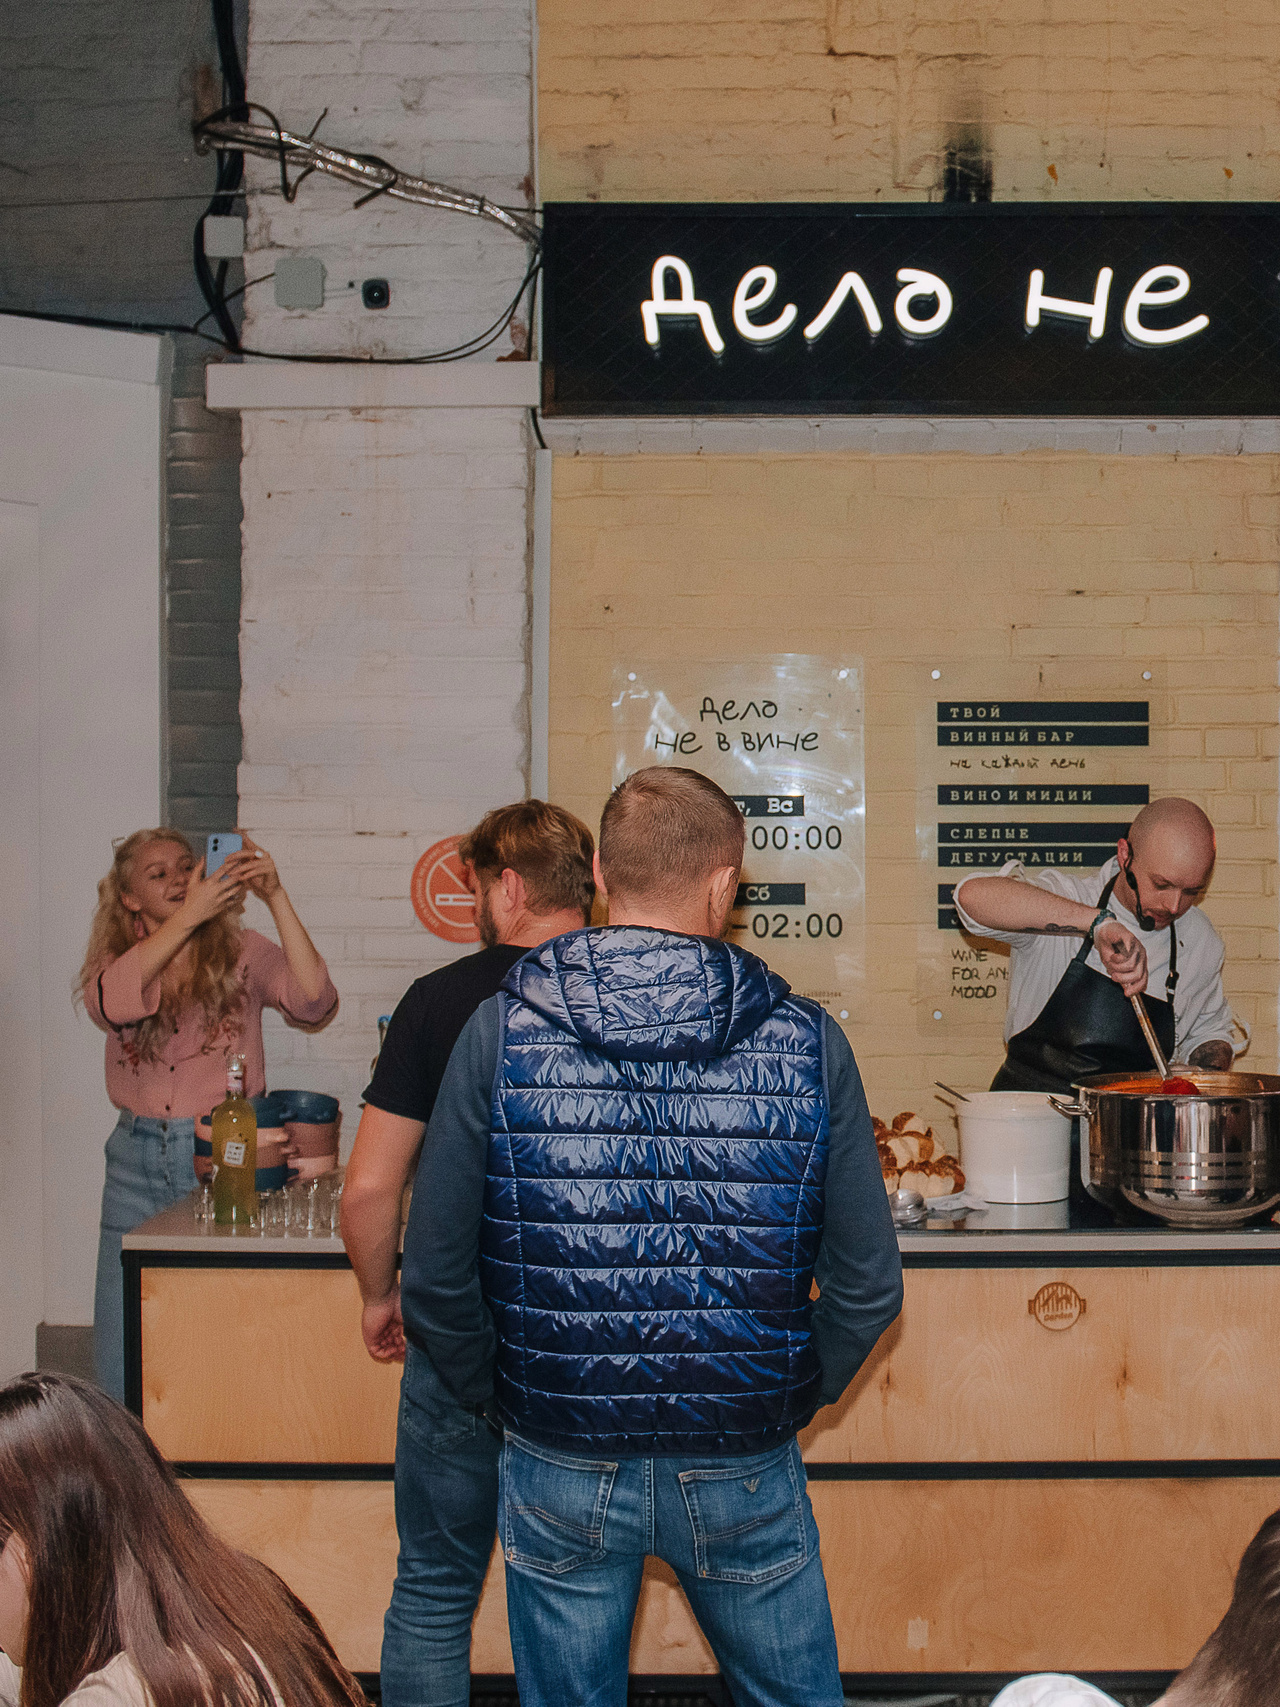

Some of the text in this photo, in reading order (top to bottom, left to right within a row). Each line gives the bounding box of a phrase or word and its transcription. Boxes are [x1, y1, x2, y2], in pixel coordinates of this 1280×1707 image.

[1026, 265, 1210, 344] не
[950, 704, 1000, 718] ТВОЙ
[950, 728, 1074, 742] ВИННЫЙ БАР
[655, 731, 819, 754] не в вине
[950, 790, 1092, 803] ВИНО И МИДИИ
[767, 797, 794, 814] Вс
[950, 828, 1029, 839] СЛЕПЫЕ
[950, 852, 1083, 864] ДЕГУСТАЦИИ
